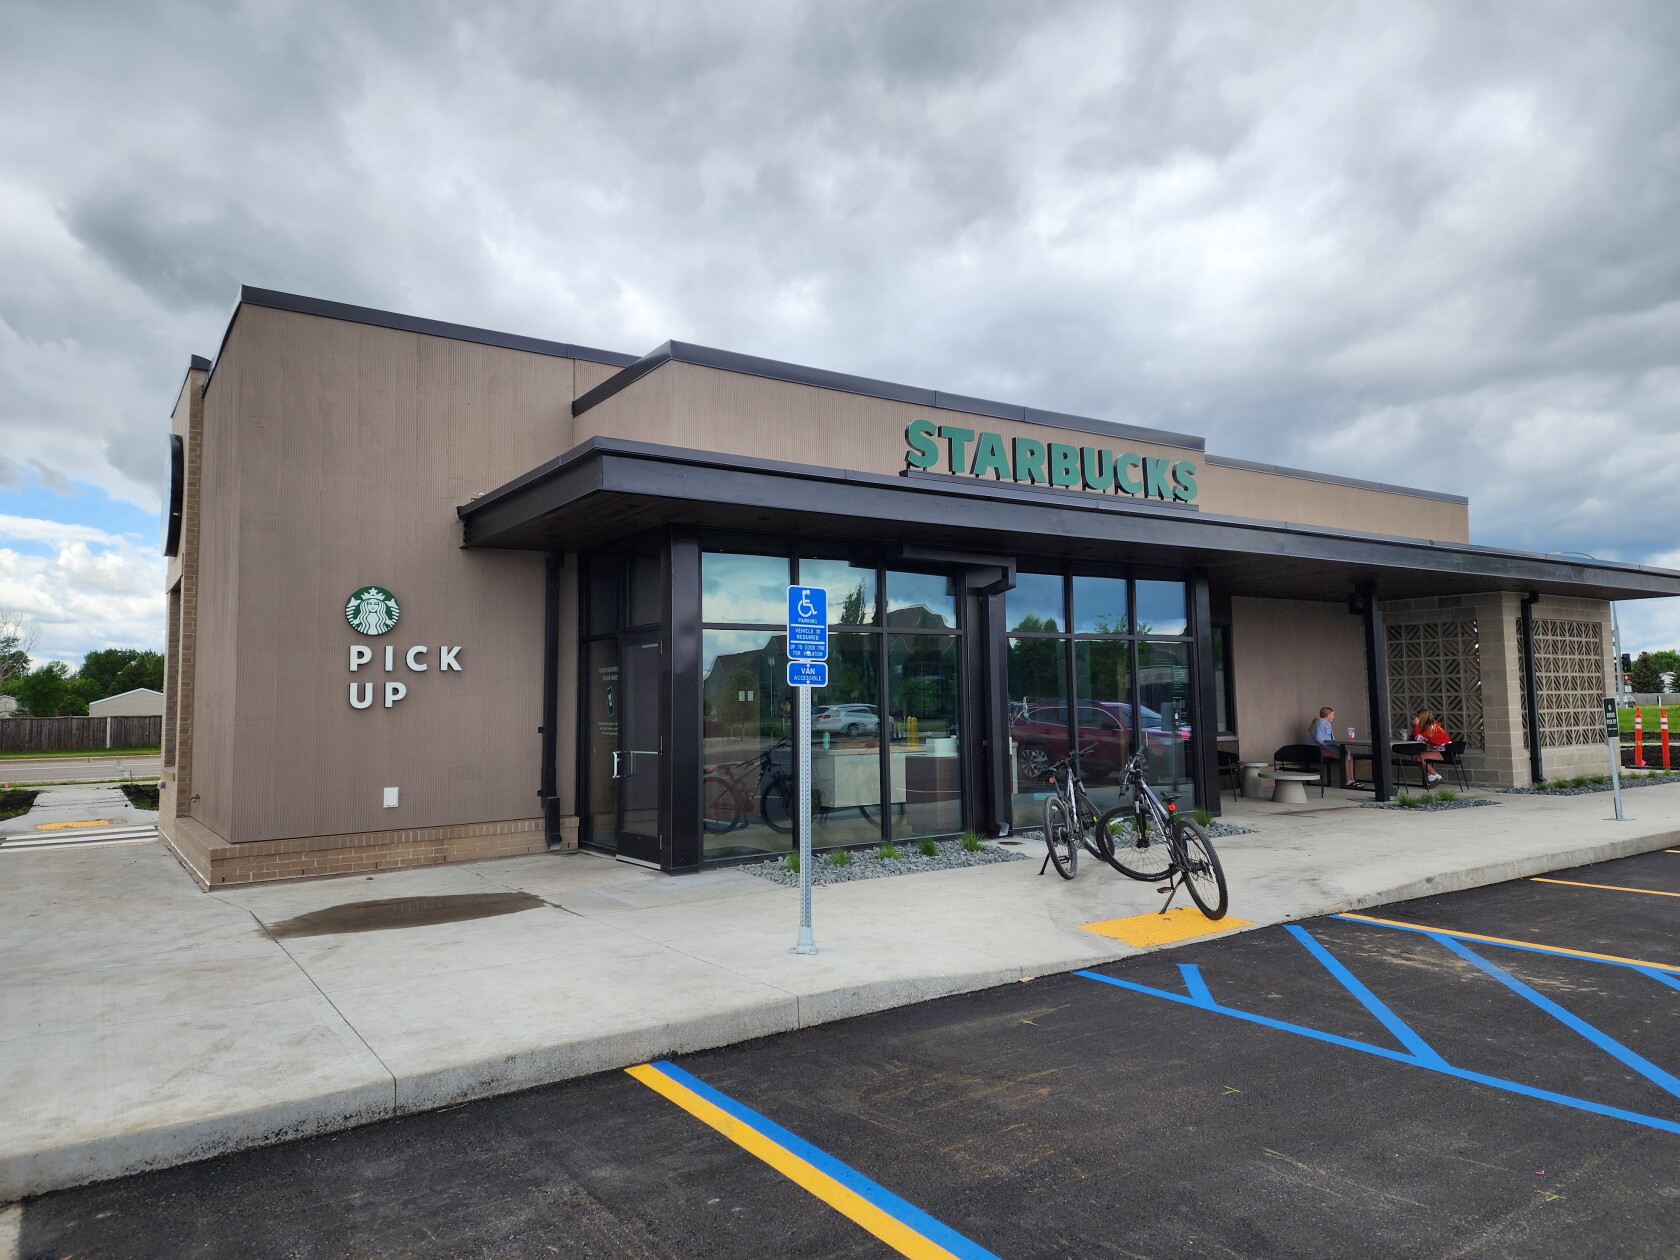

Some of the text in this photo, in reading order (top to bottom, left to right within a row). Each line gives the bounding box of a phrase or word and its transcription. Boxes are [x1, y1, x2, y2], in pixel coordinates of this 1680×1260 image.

[904, 419, 1197, 500] STARBUCKS
[349, 645, 463, 671] PICK
[349, 681, 407, 709] UP
